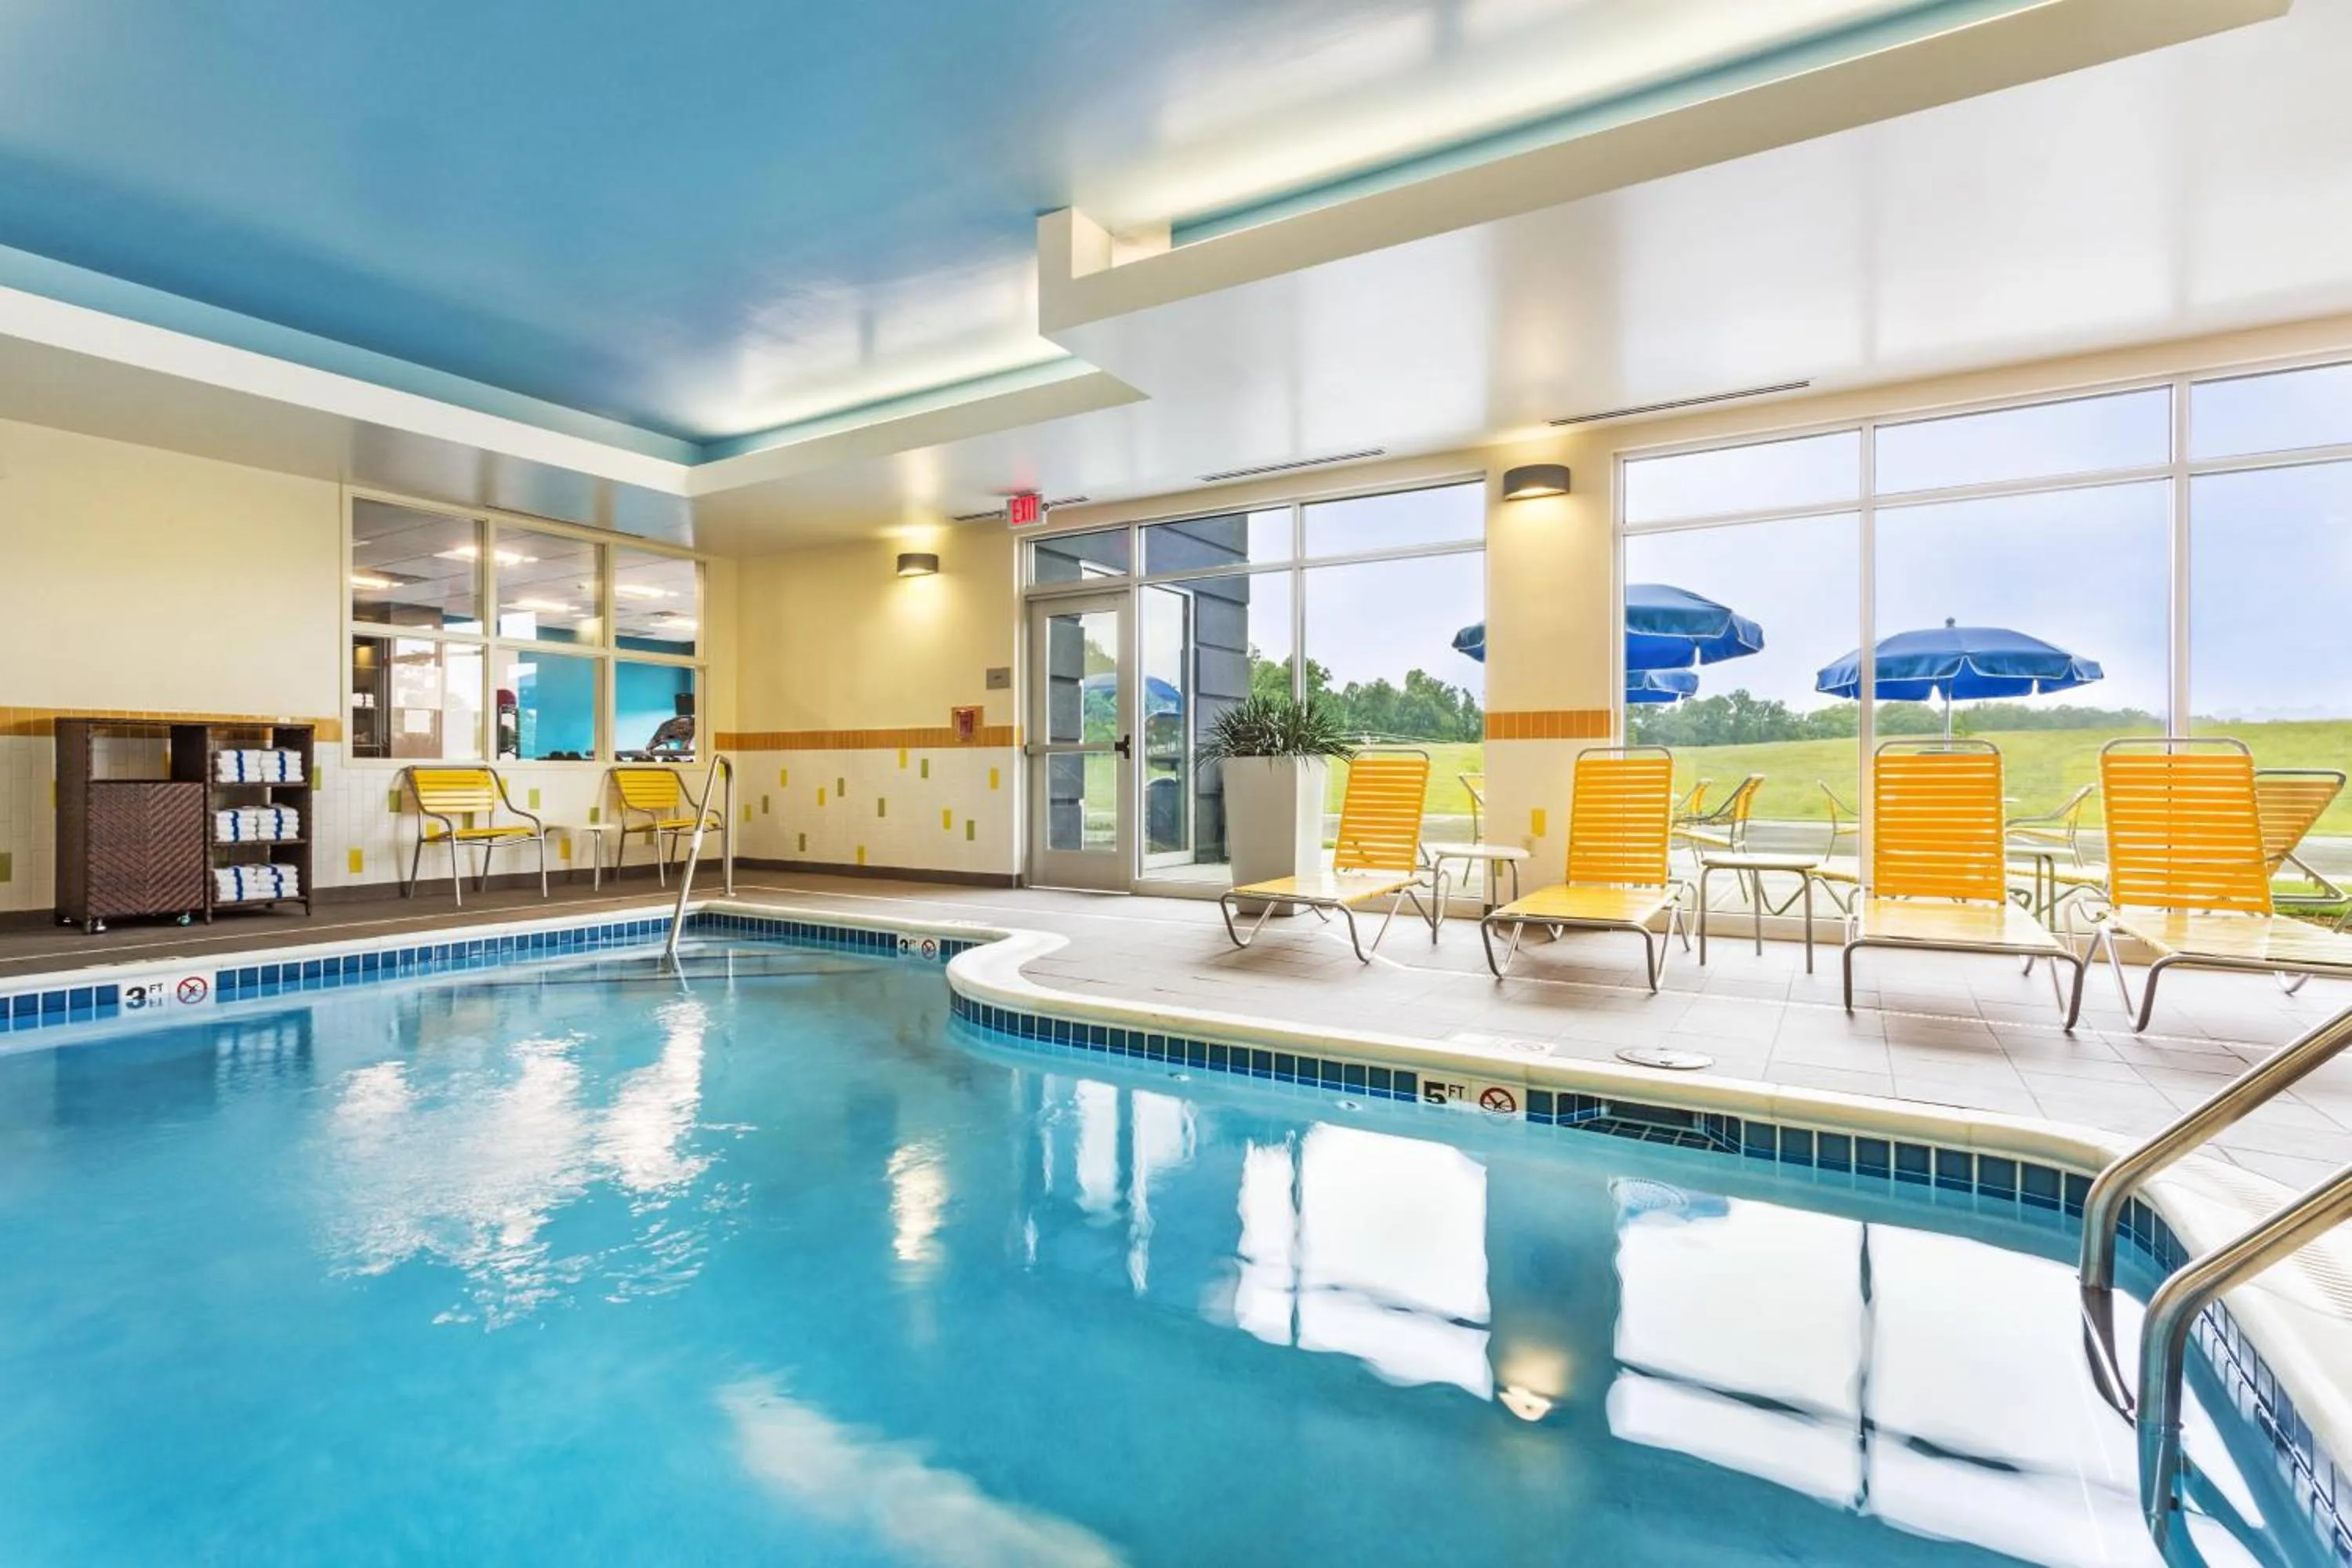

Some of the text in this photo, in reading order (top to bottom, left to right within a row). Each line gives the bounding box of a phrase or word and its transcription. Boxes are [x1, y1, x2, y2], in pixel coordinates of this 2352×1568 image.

[1011, 495, 1039, 524] EXIT
[125, 983, 164, 1007] 3 FT
[1424, 1080, 1465, 1105] 5 FT
